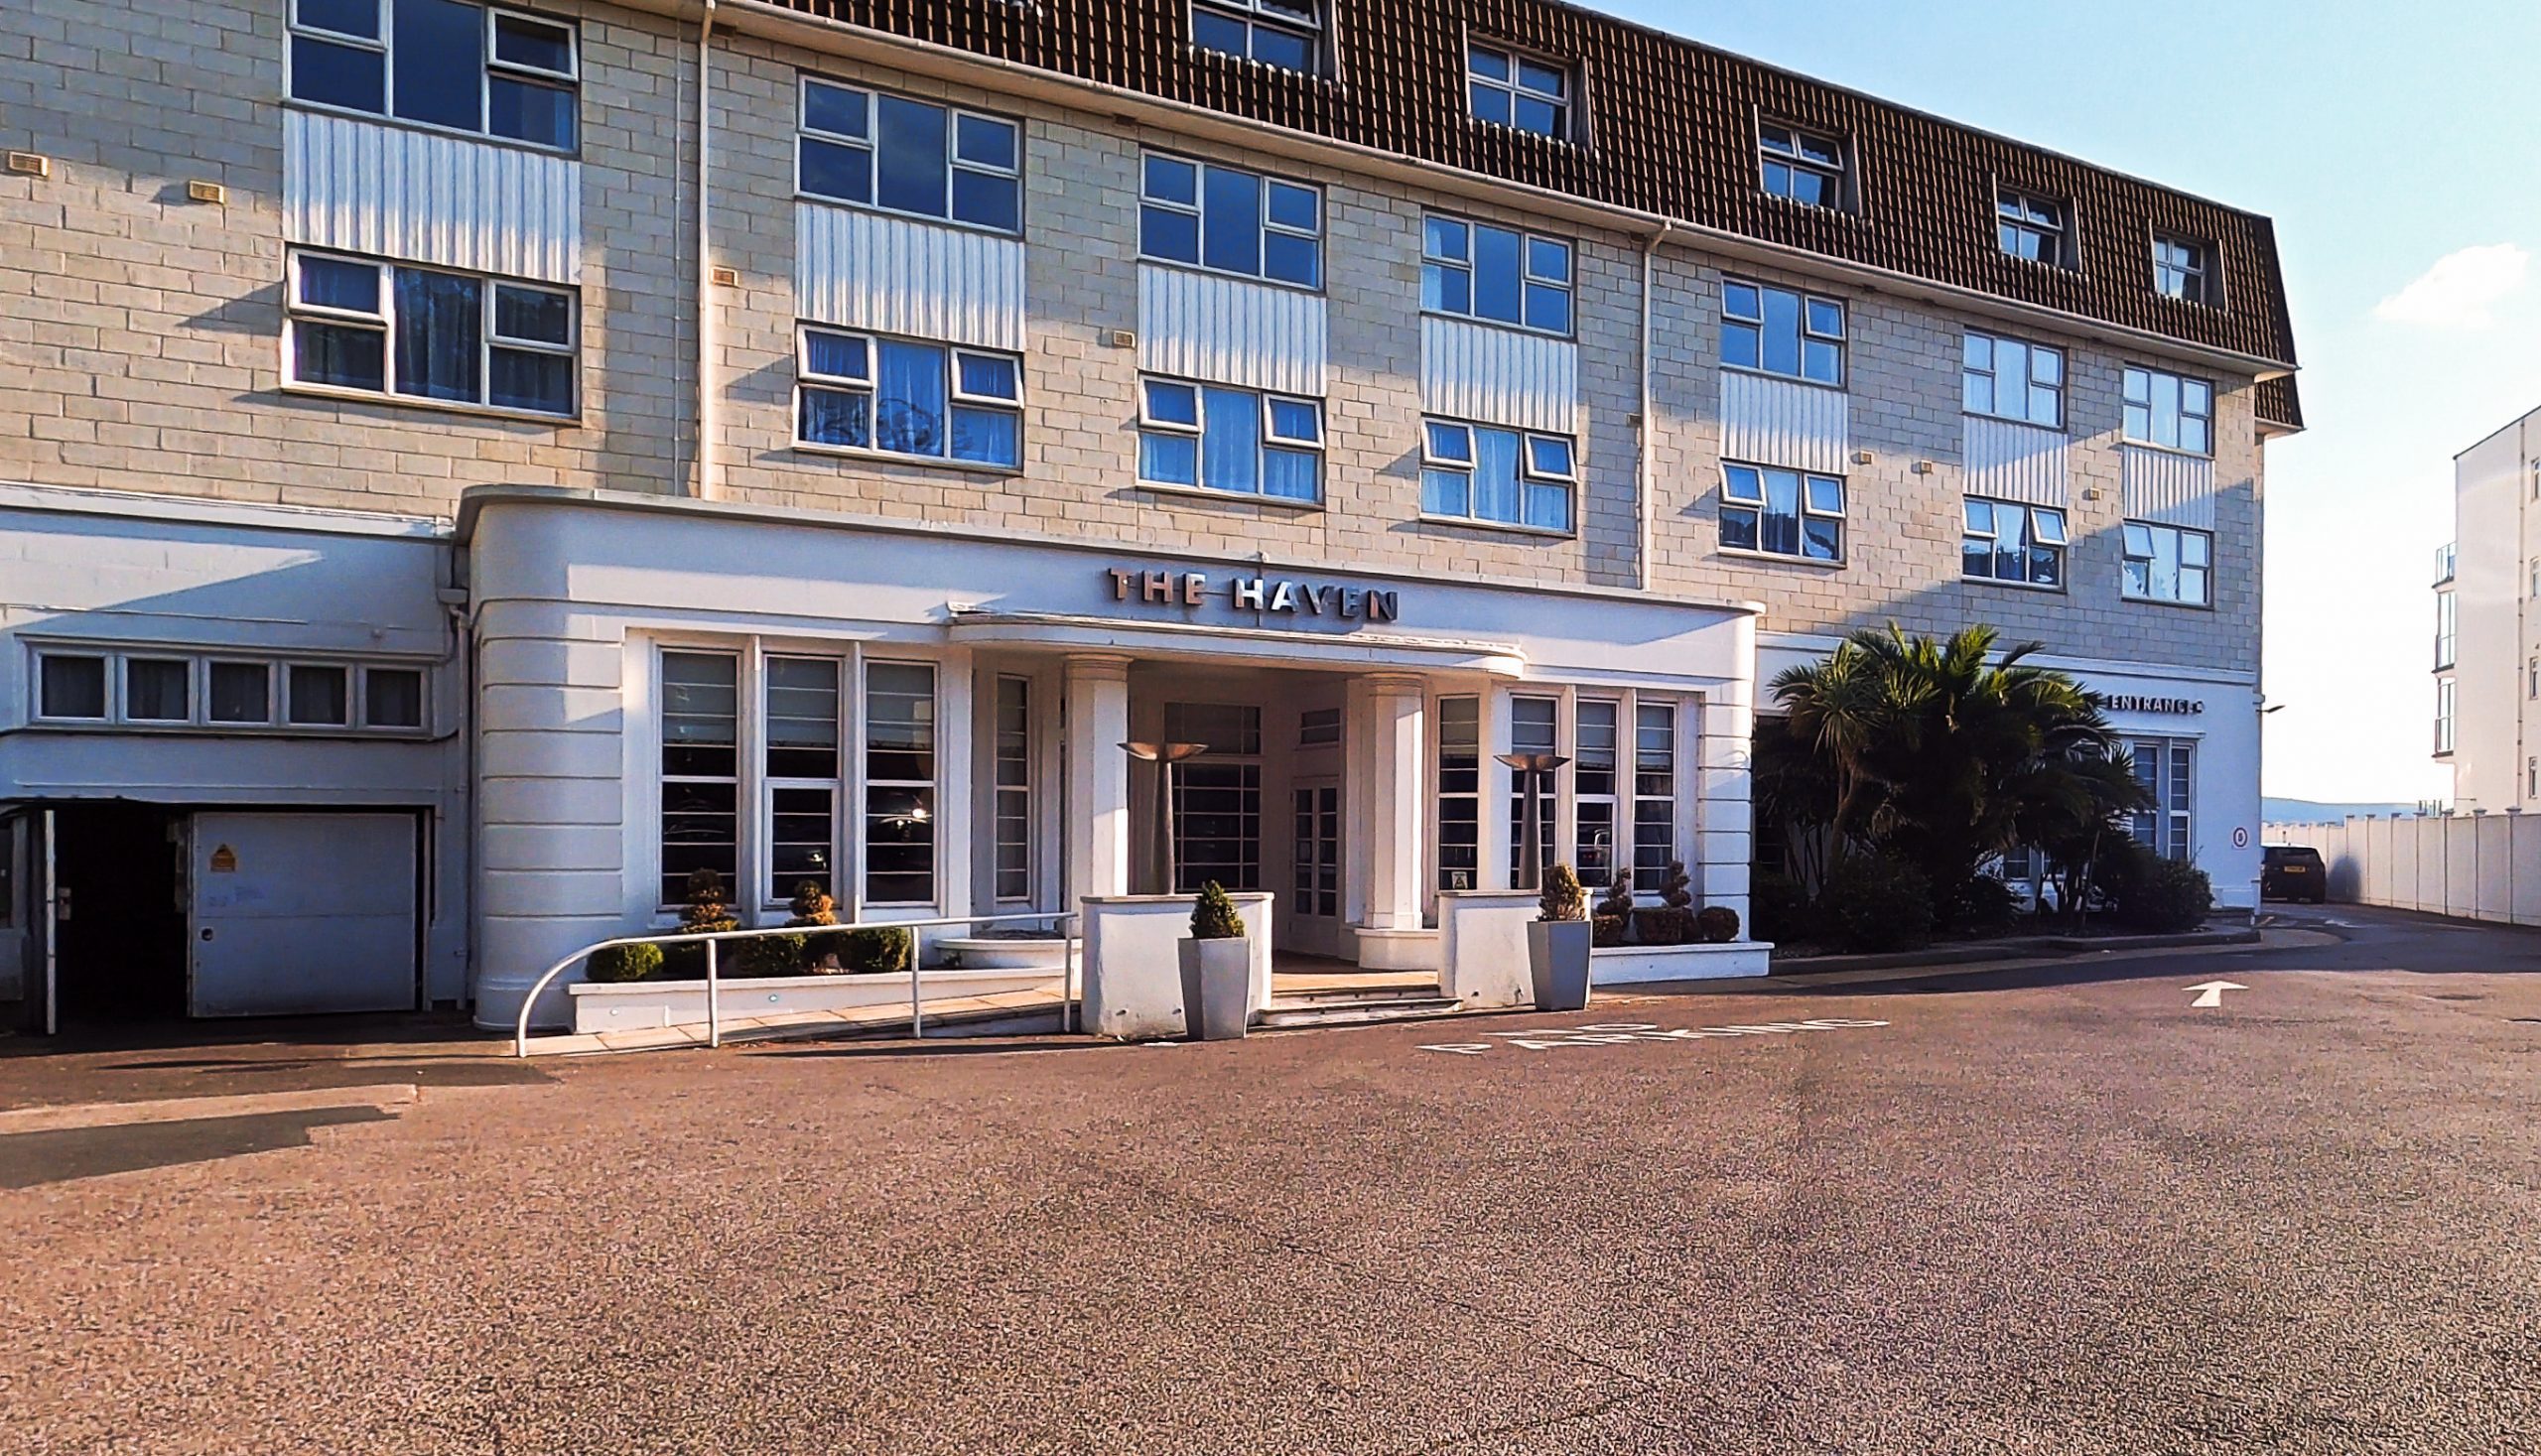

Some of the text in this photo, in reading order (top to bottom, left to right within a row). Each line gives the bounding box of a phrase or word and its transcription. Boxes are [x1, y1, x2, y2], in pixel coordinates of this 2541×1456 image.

[1108, 568, 1399, 621] THE HAVEN
[1414, 1018, 1891, 1055] PARKING
[1478, 1023, 1658, 1036] NO
